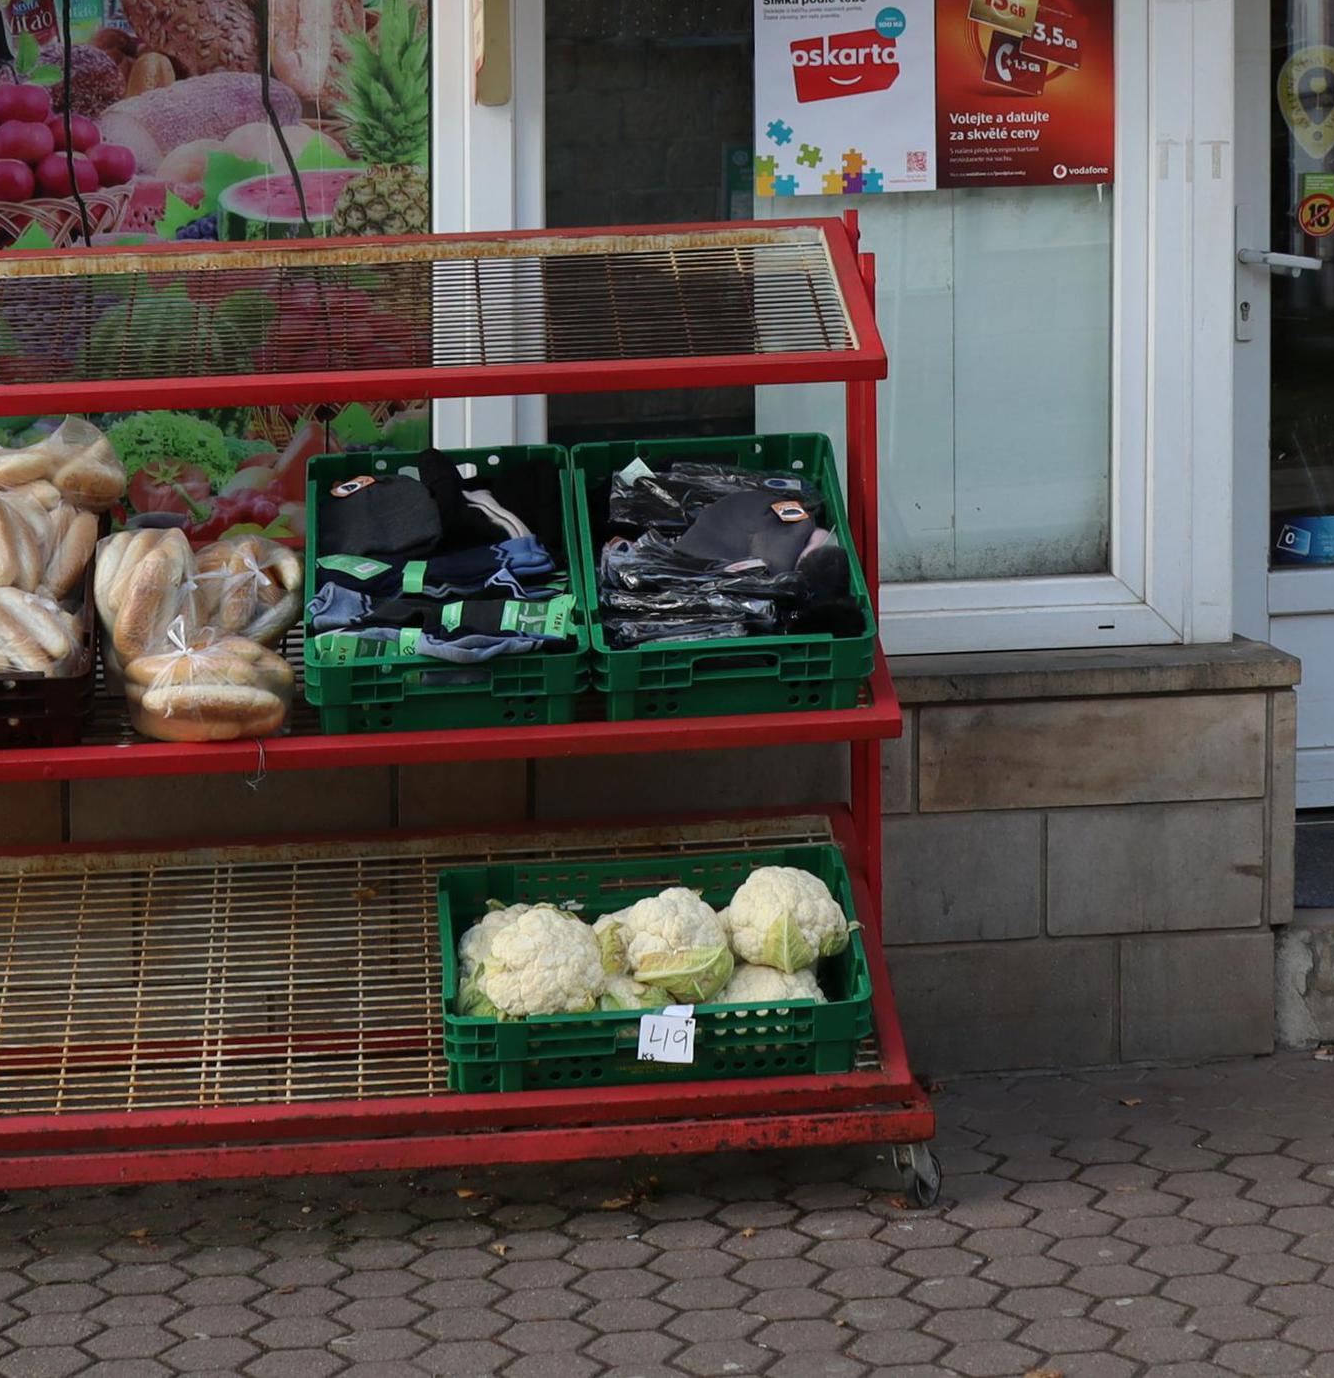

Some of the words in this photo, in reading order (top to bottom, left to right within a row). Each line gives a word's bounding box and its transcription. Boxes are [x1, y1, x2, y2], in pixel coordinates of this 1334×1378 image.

[792, 36, 899, 68] oskarta
[949, 112, 993, 126] Volejte
[996, 115, 1003, 123] a
[1006, 111, 1050, 125] datujte
[949, 131, 964, 140] za
[967, 127, 1008, 141] skvělé
[1010, 129, 1040, 141] ceny
[1068, 165, 1109, 176] vodafone
[1308, 204, 1330, 227] 18
